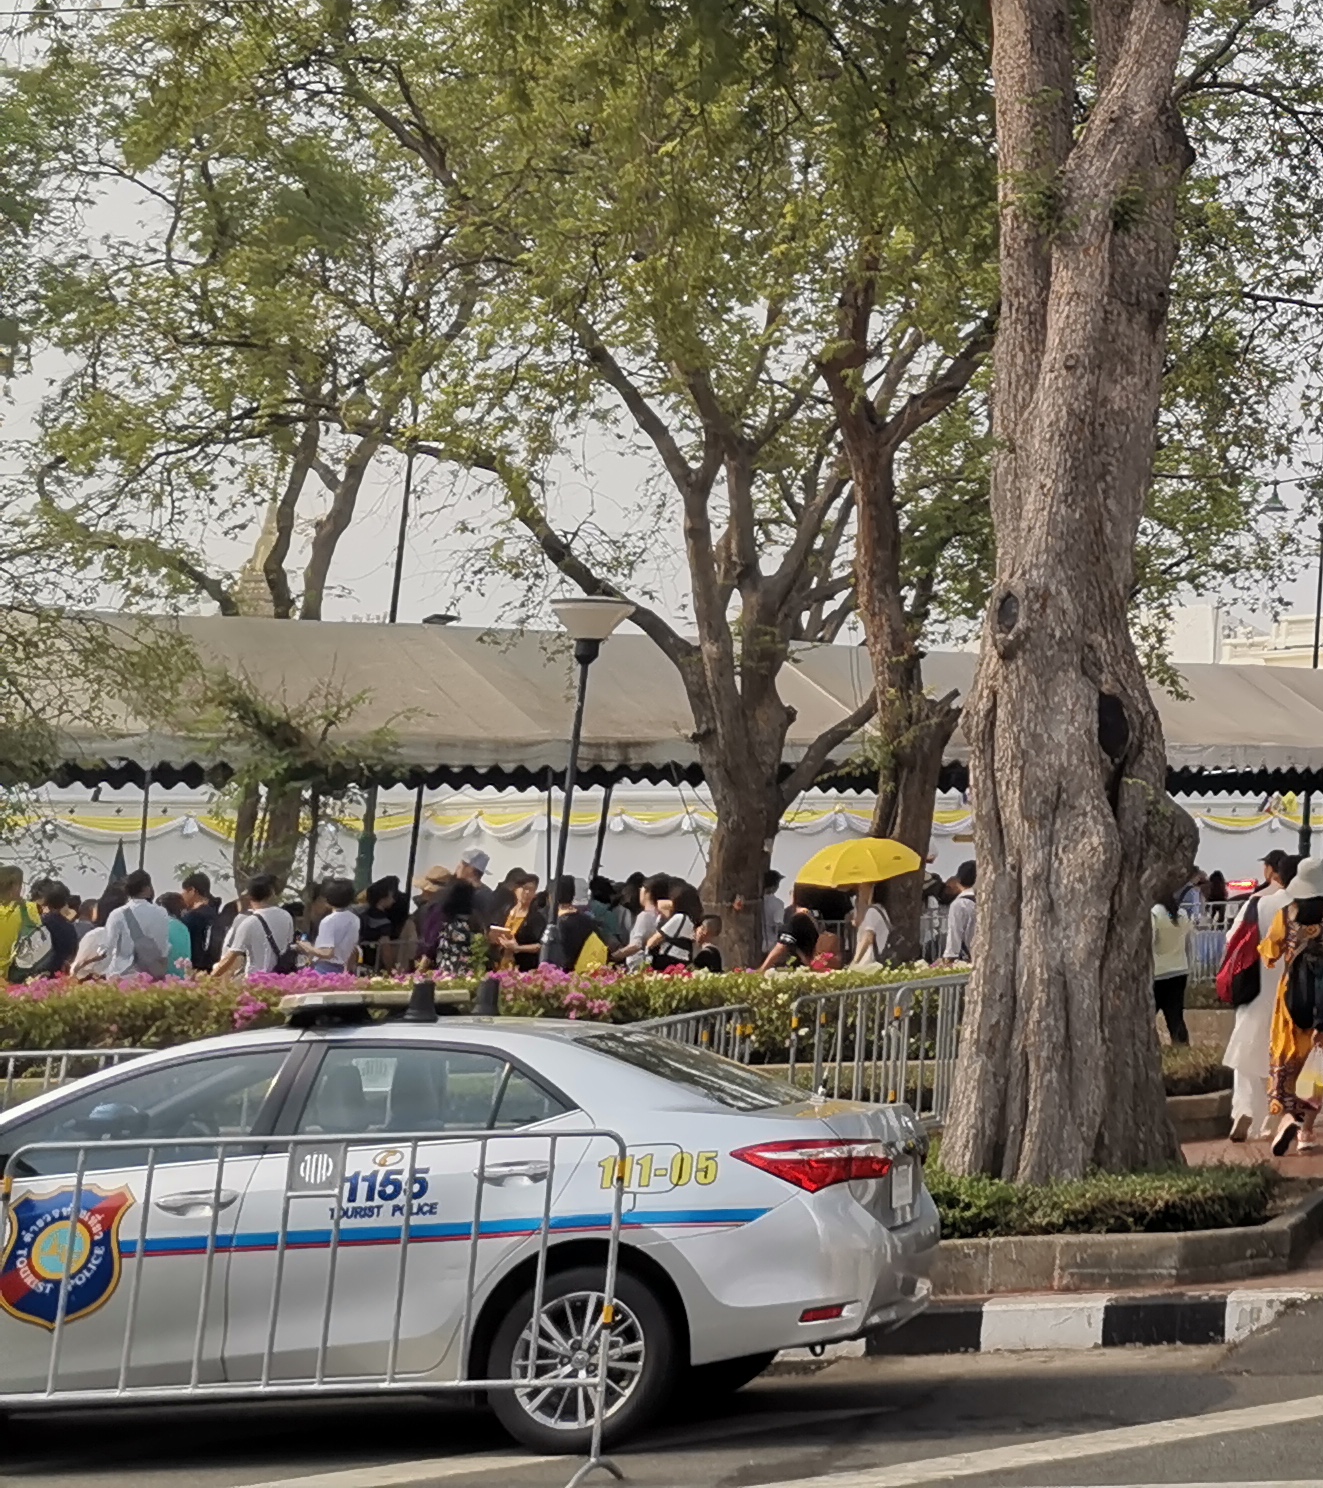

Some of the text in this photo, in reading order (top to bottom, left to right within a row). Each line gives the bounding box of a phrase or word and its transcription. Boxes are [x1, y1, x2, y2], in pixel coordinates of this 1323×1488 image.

[342, 1166, 430, 1204] 1155
[598, 1150, 719, 1189] 111-05
[15, 1247, 55, 1295] TOURIST
